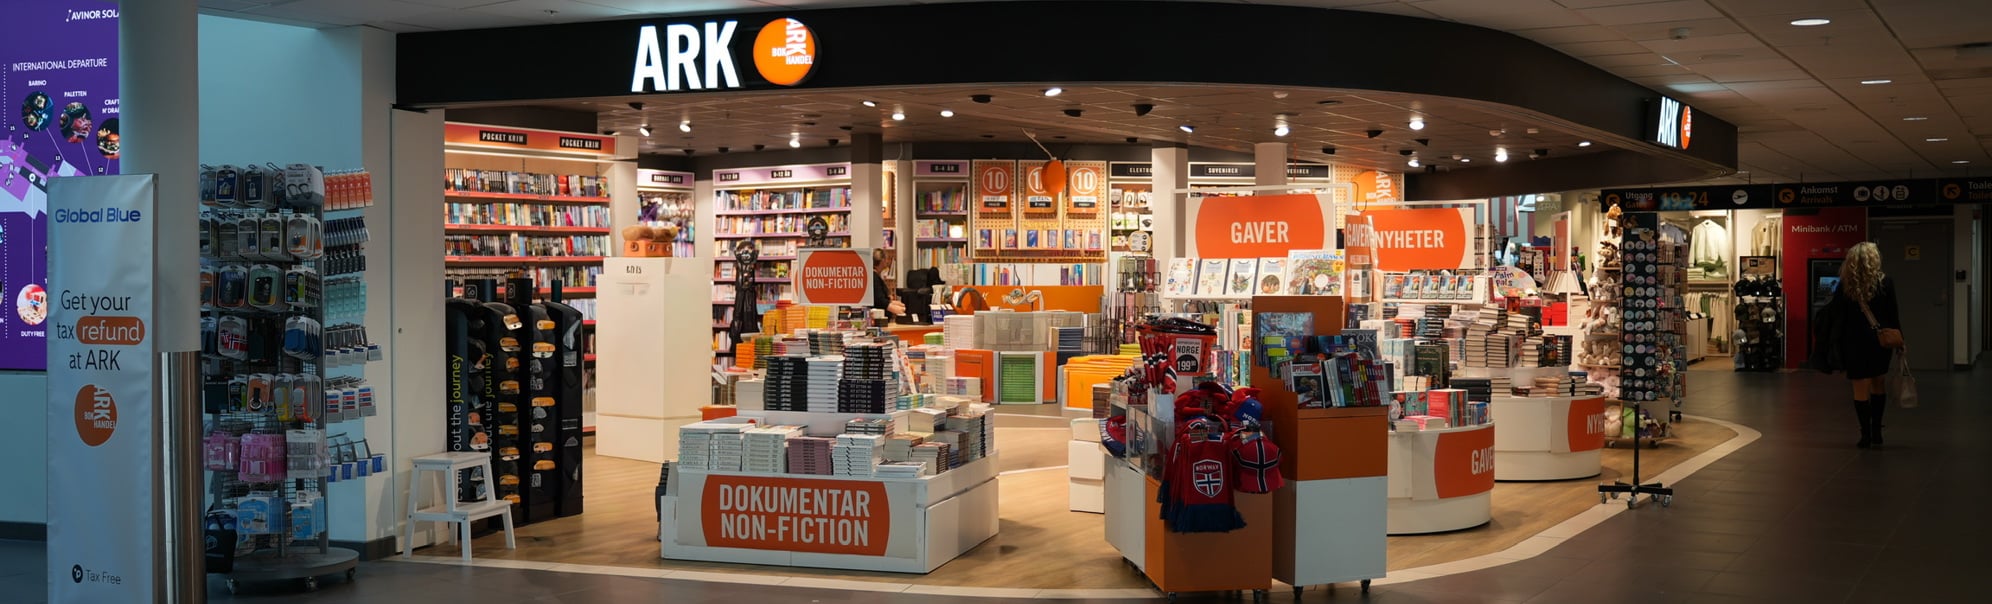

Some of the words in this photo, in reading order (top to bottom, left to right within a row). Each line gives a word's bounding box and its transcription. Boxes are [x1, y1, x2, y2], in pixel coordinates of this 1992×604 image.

[71, 10, 100, 20] AVINOR
[786, 17, 806, 56] ARK
[631, 20, 740, 93] ARK
[785, 56, 813, 65] HANDEL
[12, 61, 67, 72] INTERNATIONAL
[67, 58, 108, 69] DEPARTURE
[1657, 96, 1679, 148] ARK
[482, 132, 507, 142] POCKET
[507, 134, 524, 143] KRIM
[561, 138, 583, 148] POCKET
[584, 140, 599, 149] KRIM
[987, 171, 1004, 190] 10
[1076, 171, 1093, 190] 10
[1800, 186, 1838, 194] Ankomst
[1625, 192, 1653, 201] Utgang
[1662, 191, 1709, 207] 19-24
[55, 208, 103, 223] Global
[106, 207, 142, 222] Blue
[1230, 220, 1290, 244] GAVER
[1791, 225, 1831, 233] Minibank
[1837, 224, 1858, 233] ATM
[1375, 229, 1444, 249] NYHETER
[1908, 248, 1917, 257] C
[805, 266, 864, 278] DOKUMENTAR
[1494, 271, 1515, 279] Palm
[806, 278, 864, 289] NON-FICTION
[60, 289, 87, 311] Get
[90, 295, 132, 316] your
[56, 321, 75, 340] tax
[81, 319, 141, 341] refund
[1176, 345, 1200, 354] NORGE
[69, 352, 81, 370] at
[84, 349, 121, 371] ARK
[450, 354, 464, 403] journey
[450, 404, 461, 423] the
[719, 483, 871, 518] DOKUMENTAR
[721, 512, 869, 547] NON-FICTION
[85, 569, 100, 582] Tax
[102, 571, 121, 585] Free
